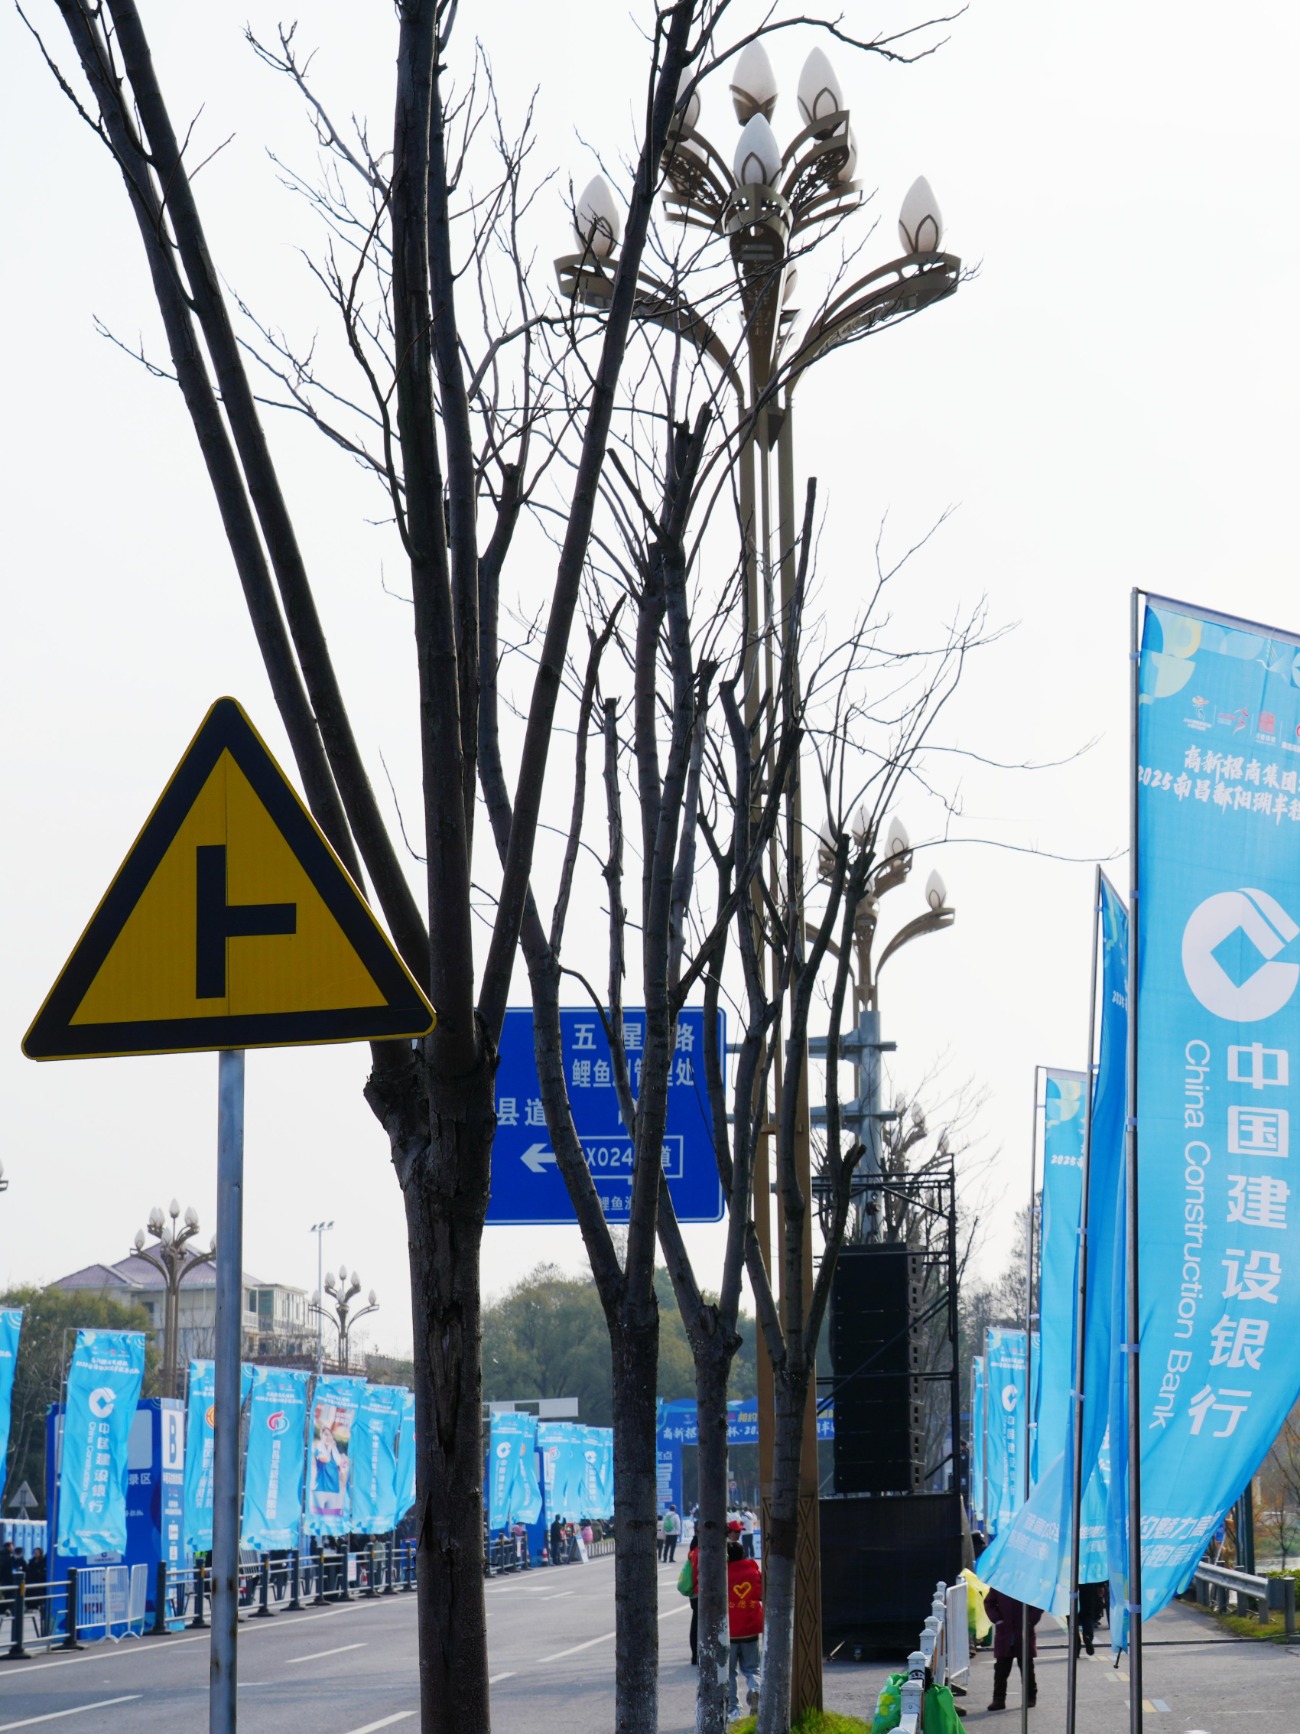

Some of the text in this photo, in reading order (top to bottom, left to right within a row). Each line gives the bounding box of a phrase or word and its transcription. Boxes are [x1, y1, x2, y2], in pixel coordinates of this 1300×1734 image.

[571, 1023, 695, 1052] 五星路
[1149, 1039, 1211, 1430] China Construction Bank
[1187, 1042, 1291, 1438] 中国建设银行
